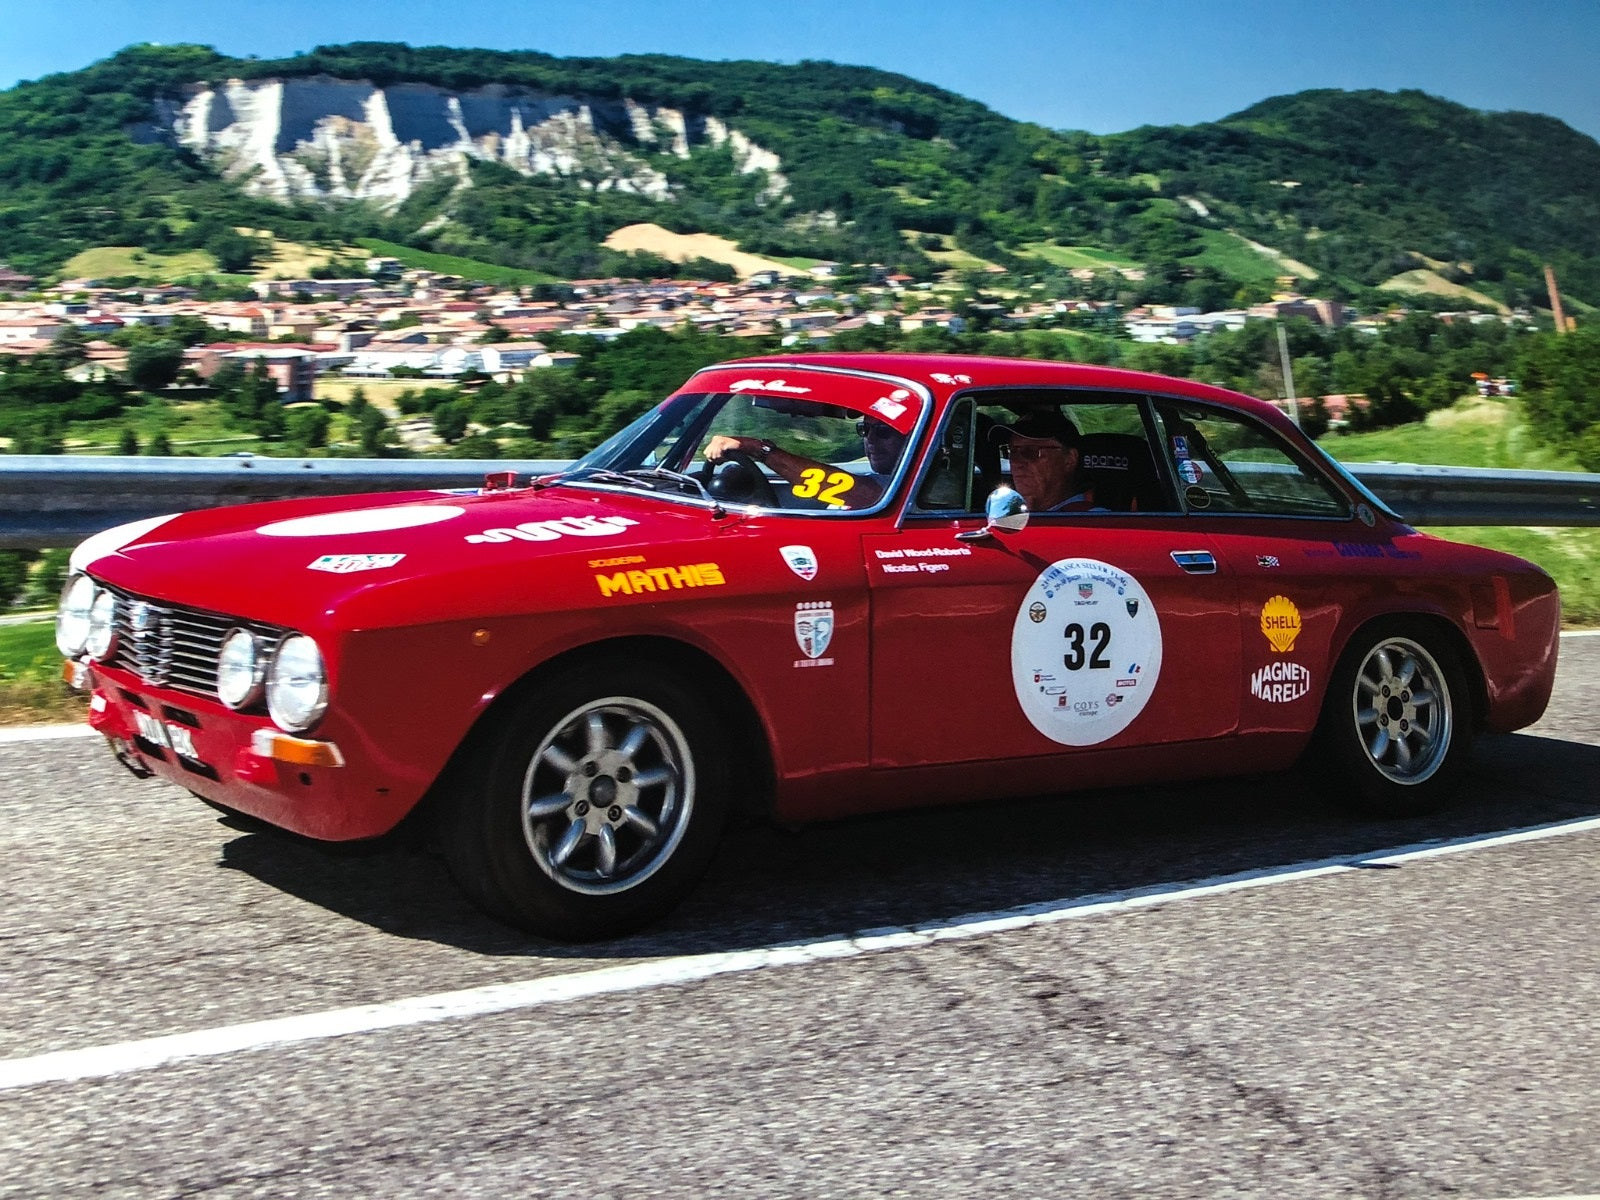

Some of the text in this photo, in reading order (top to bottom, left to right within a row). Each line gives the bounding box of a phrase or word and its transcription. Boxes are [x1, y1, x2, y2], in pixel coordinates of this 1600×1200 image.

[1083, 454, 1129, 470] sparco
[792, 468, 855, 507] 32
[875, 547, 972, 559] David Wood-Roberts
[594, 562, 727, 597] MATHIS
[882, 562, 950, 574] Nicolas Figero
[1265, 616, 1298, 630] SHELL
[1064, 622, 1111, 671] 32
[1251, 661, 1310, 687] MAGNETI
[1251, 679, 1310, 703] MARELLI
